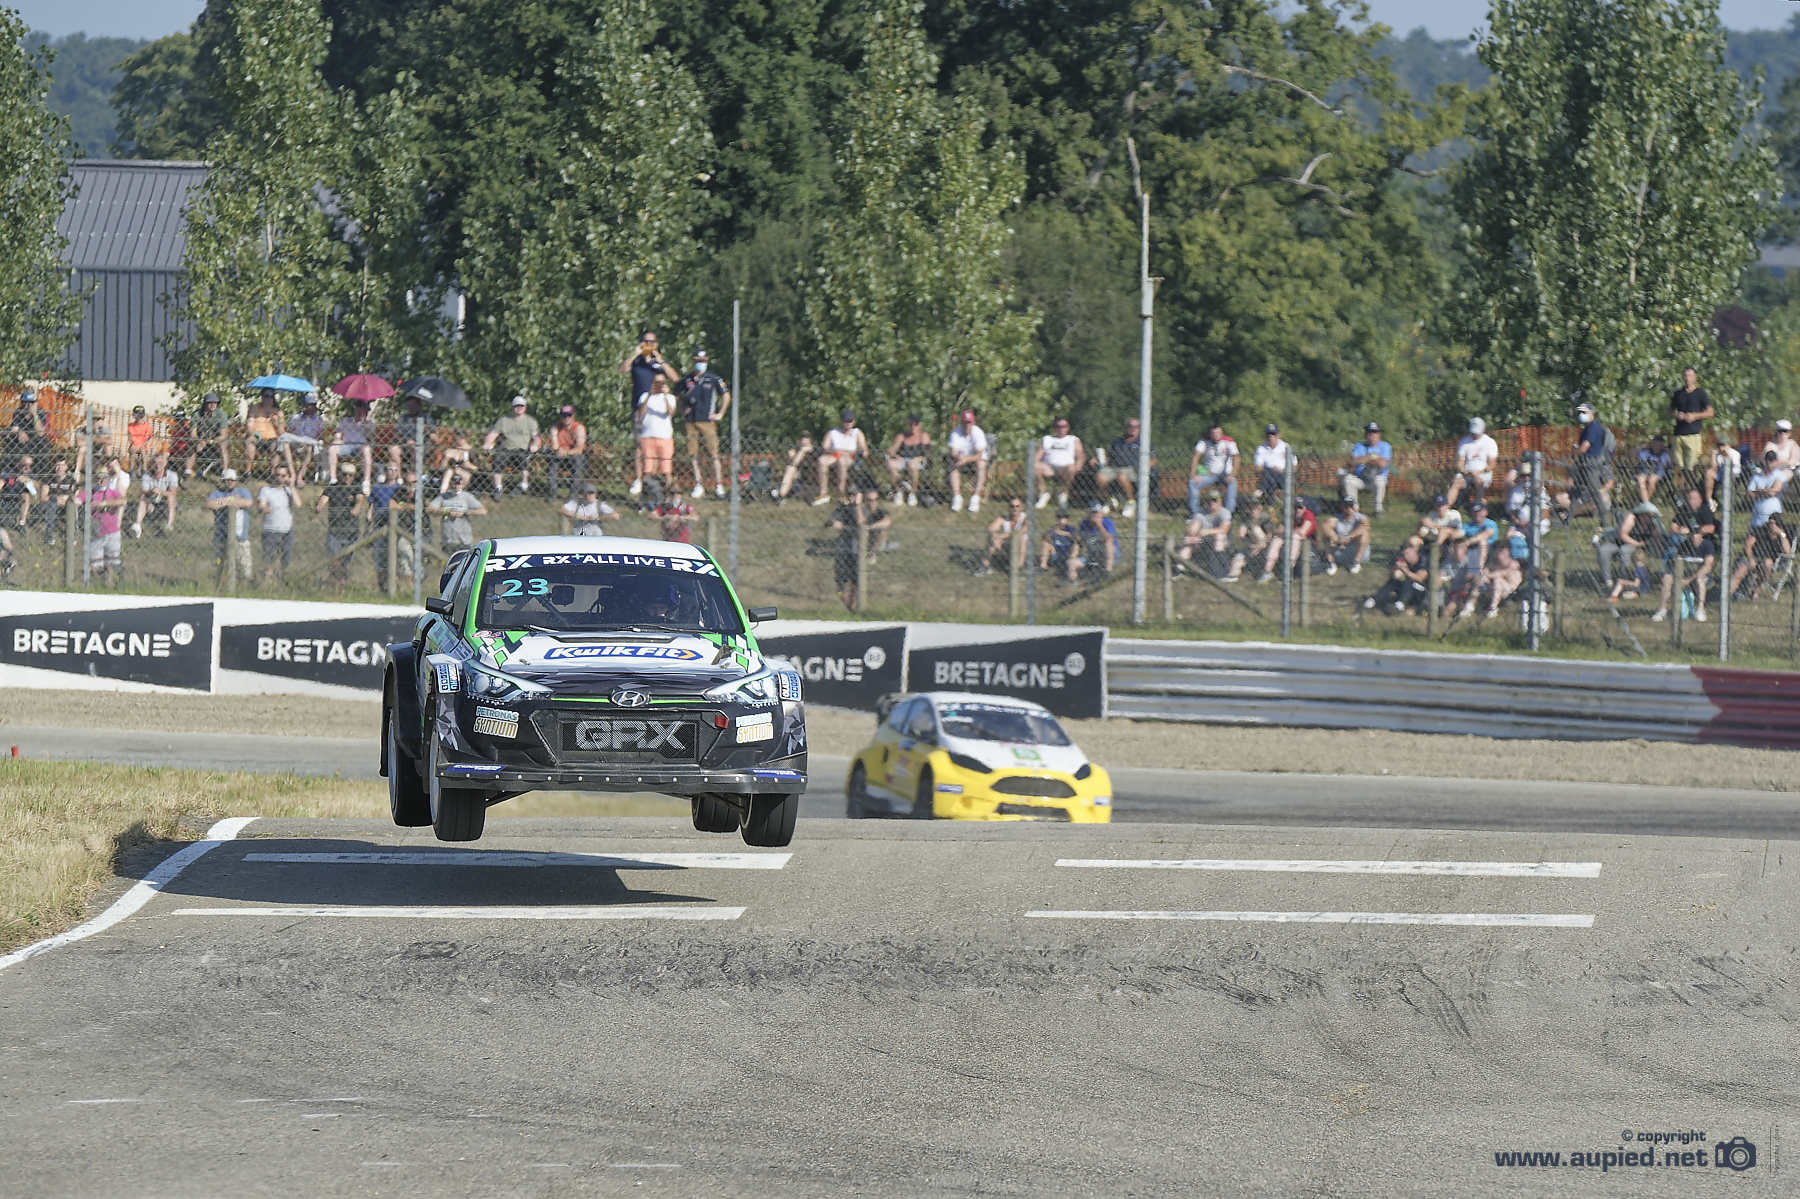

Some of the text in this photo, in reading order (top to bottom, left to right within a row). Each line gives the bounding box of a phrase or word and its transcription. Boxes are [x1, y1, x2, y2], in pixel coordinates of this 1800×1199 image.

[624, 557, 666, 568] LIVE
[670, 558, 720, 577] RX
[500, 578, 549, 598] 23
[13, 628, 170, 658] BRETAGNE
[934, 660, 1065, 689] BRETAGNE
[476, 706, 519, 722] PETRONAS
[474, 717, 518, 738] SYNTIUM
[575, 720, 686, 750] GRX
